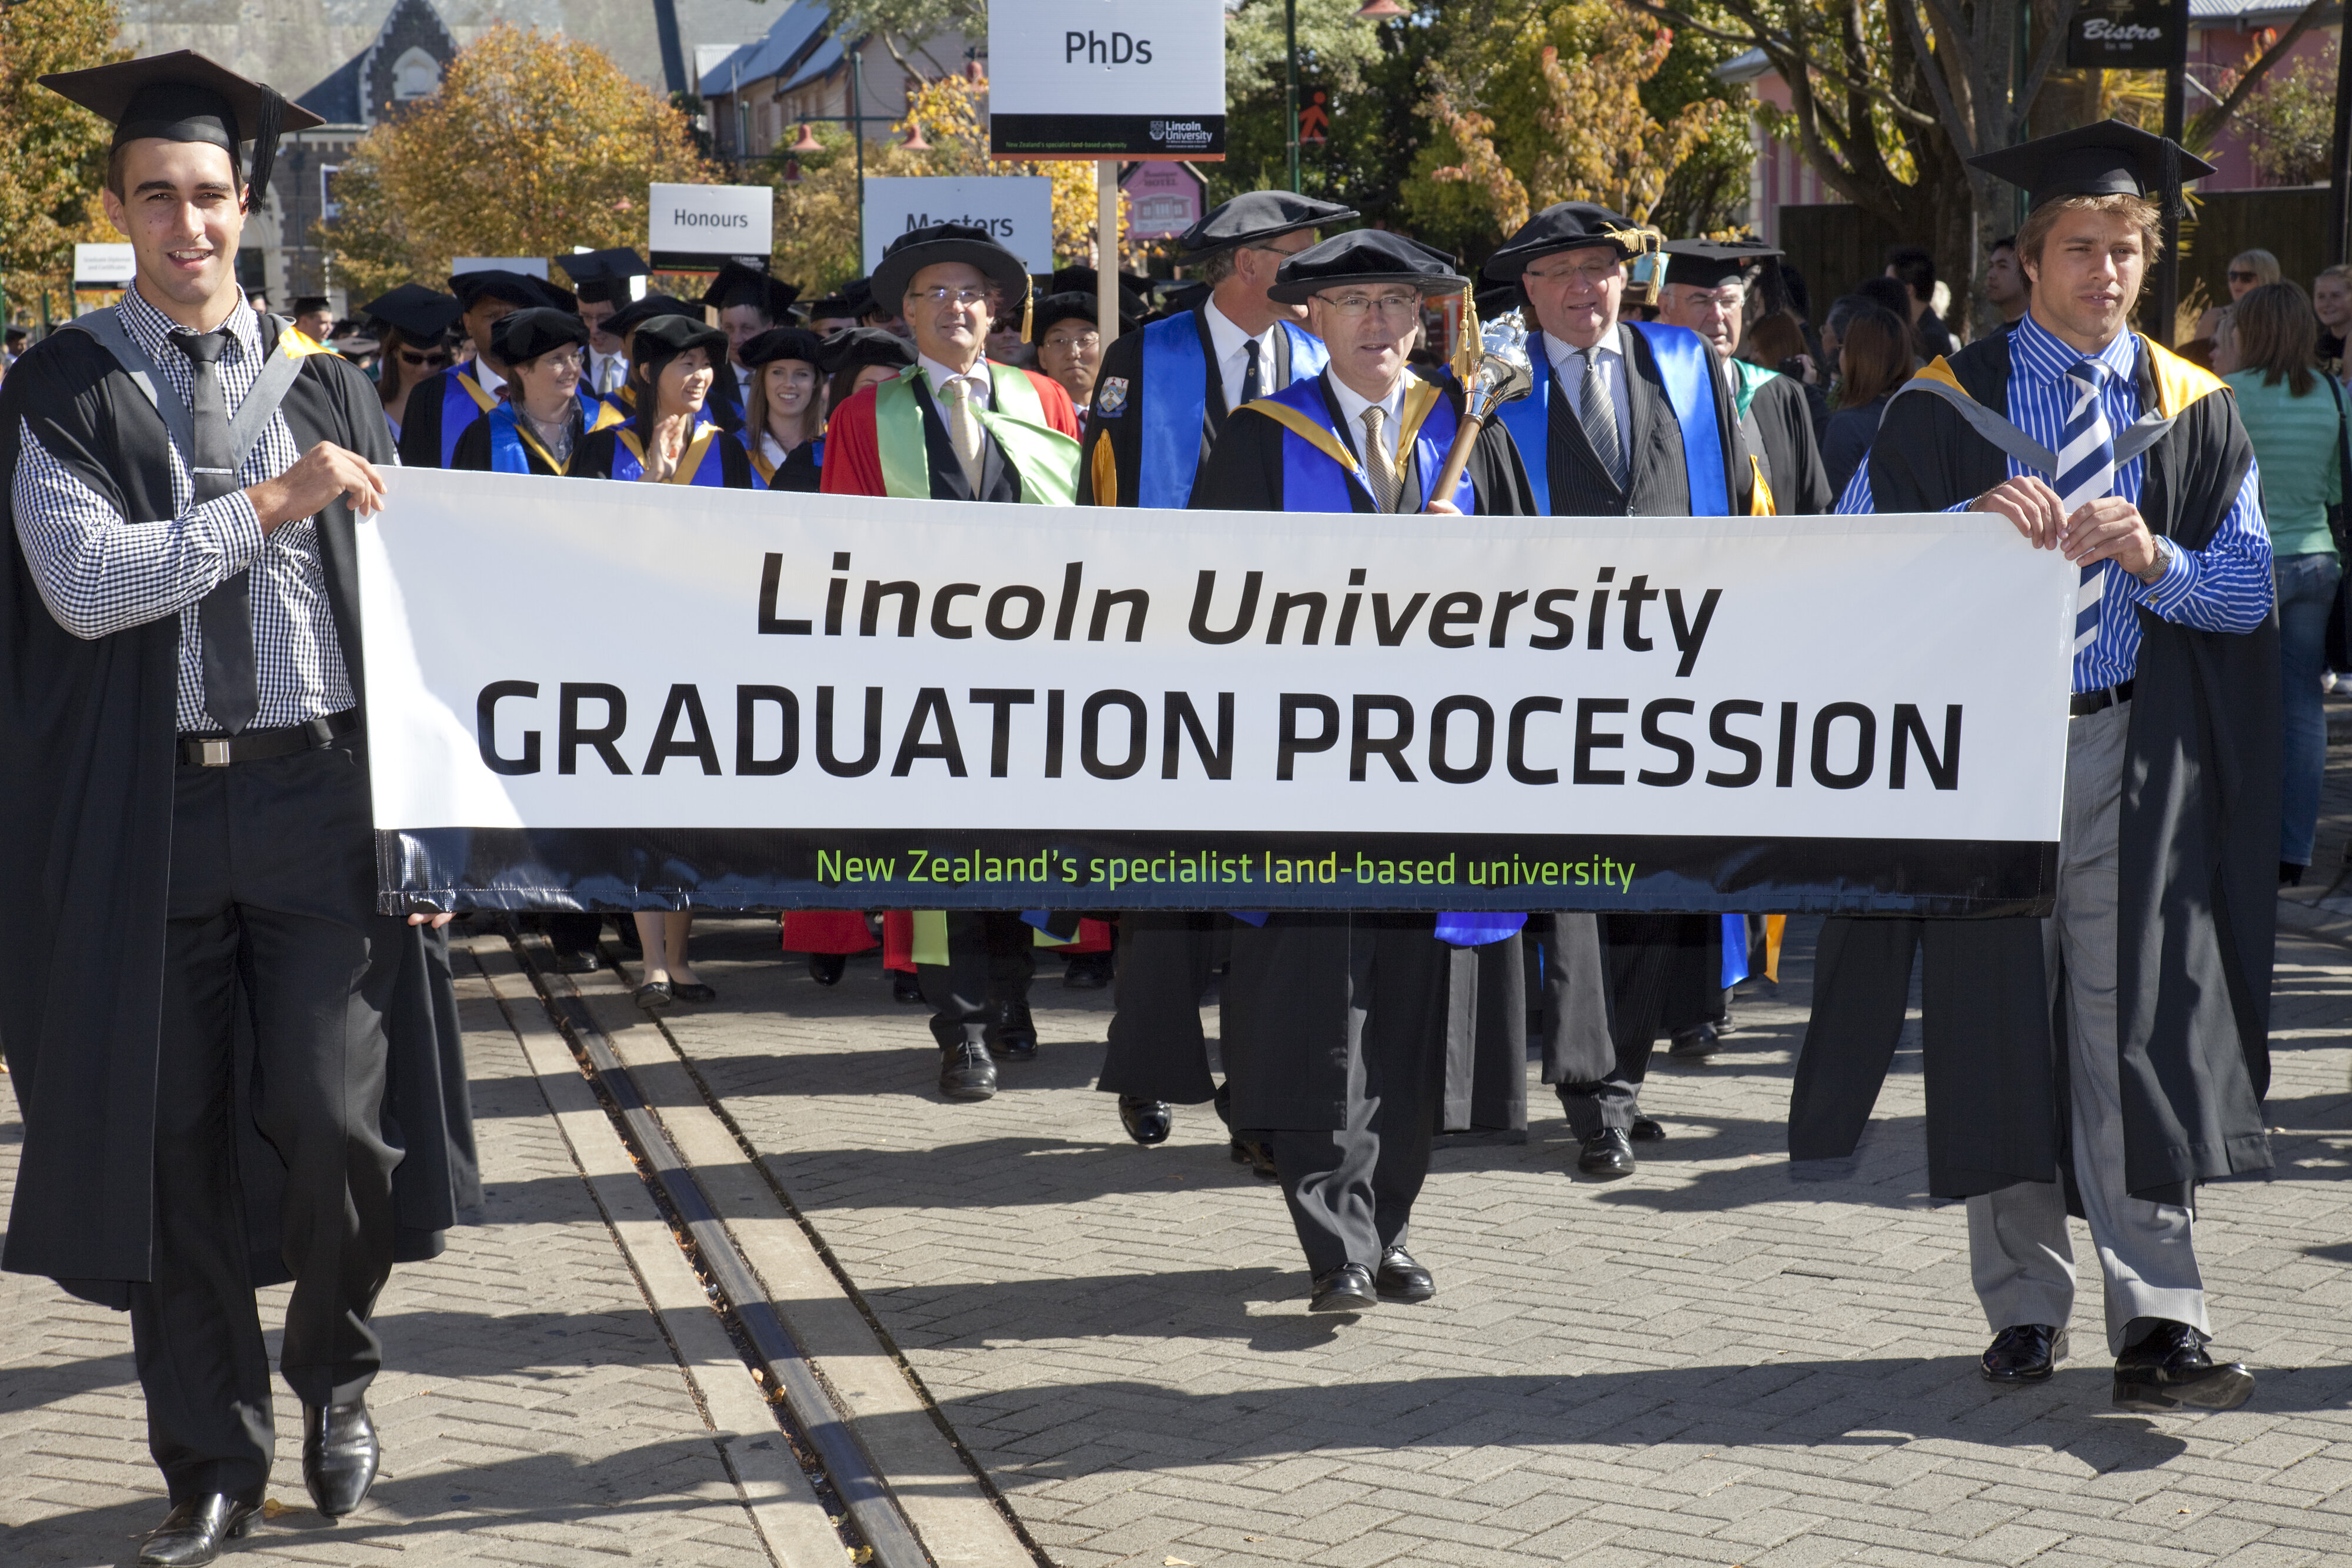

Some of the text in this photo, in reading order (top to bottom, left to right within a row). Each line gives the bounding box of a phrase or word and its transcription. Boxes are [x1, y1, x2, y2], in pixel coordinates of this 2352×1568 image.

[2083, 18, 2162, 41] Bistro
[1066, 30, 1152, 64] PhDs
[1166, 121, 1201, 131] Lincoln
[1166, 130, 1212, 142] University
[675, 209, 748, 228] Honours
[758, 552, 1723, 678] Lincoln University
[476, 680, 1963, 790] GRADUATION PROCESSION
[818, 849, 1636, 894] New Zealand's specialist land-based university
